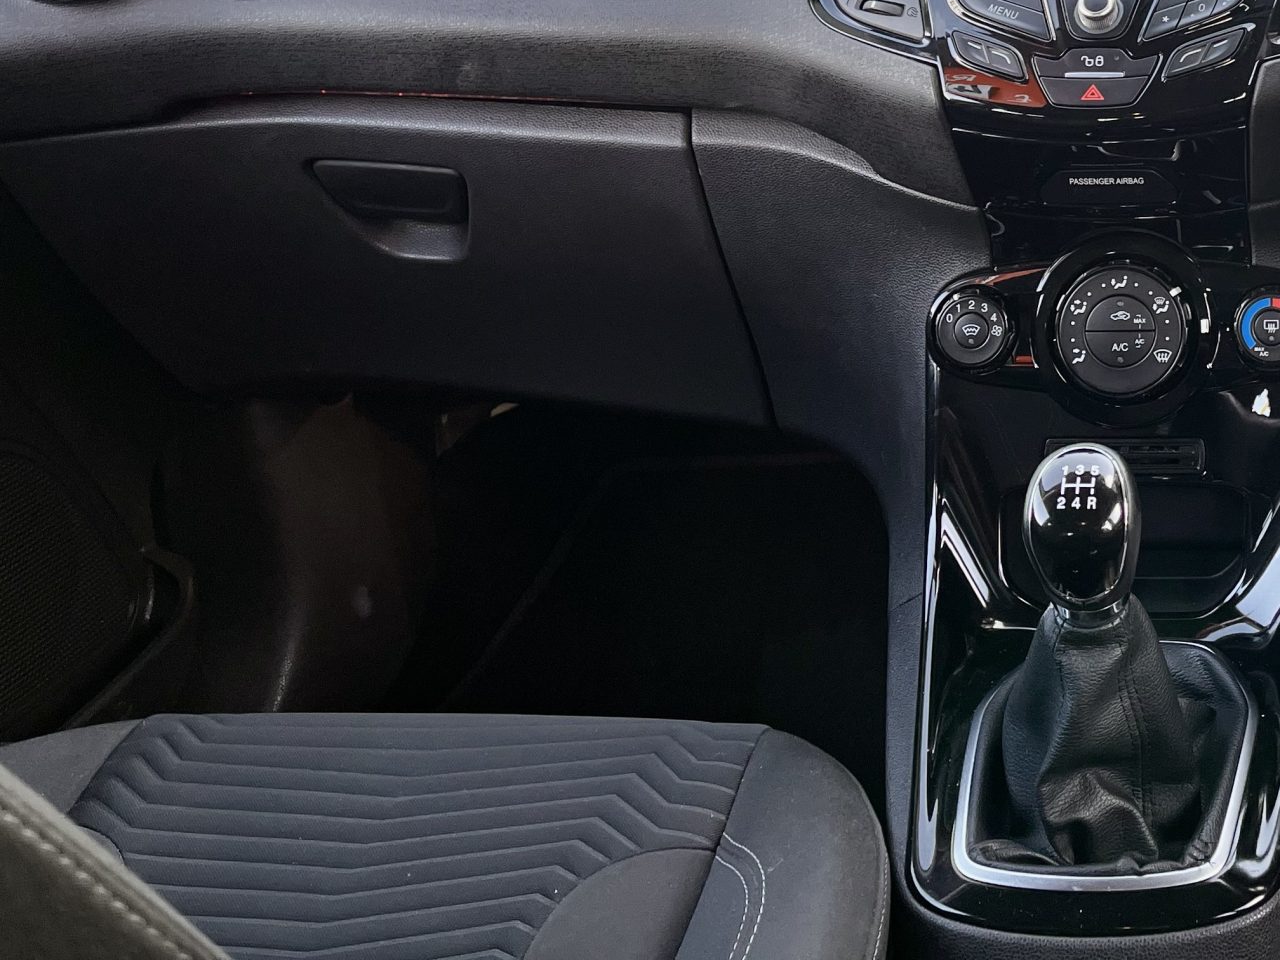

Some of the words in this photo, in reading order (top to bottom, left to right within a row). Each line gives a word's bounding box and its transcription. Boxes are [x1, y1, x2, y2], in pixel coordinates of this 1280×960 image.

[988, 3, 1019, 20] MENU
[1198, 3, 1206, 12] 0
[1068, 177, 1115, 186] PASSENGER
[1116, 177, 1145, 185] AIRBAG
[955, 303, 961, 313] 1
[968, 300, 975, 310] 2
[981, 303, 988, 313] 3
[946, 314, 953, 323] 0
[990, 312, 997, 322] 4
[1111, 342, 1129, 352] A/C
[1062, 465, 1069, 476] 1
[1075, 465, 1085, 476] 3
[1091, 465, 1100, 476] 5
[1056, 496, 1066, 510] 2
[1071, 496, 1081, 510] 4
[1086, 496, 1097, 510] R
